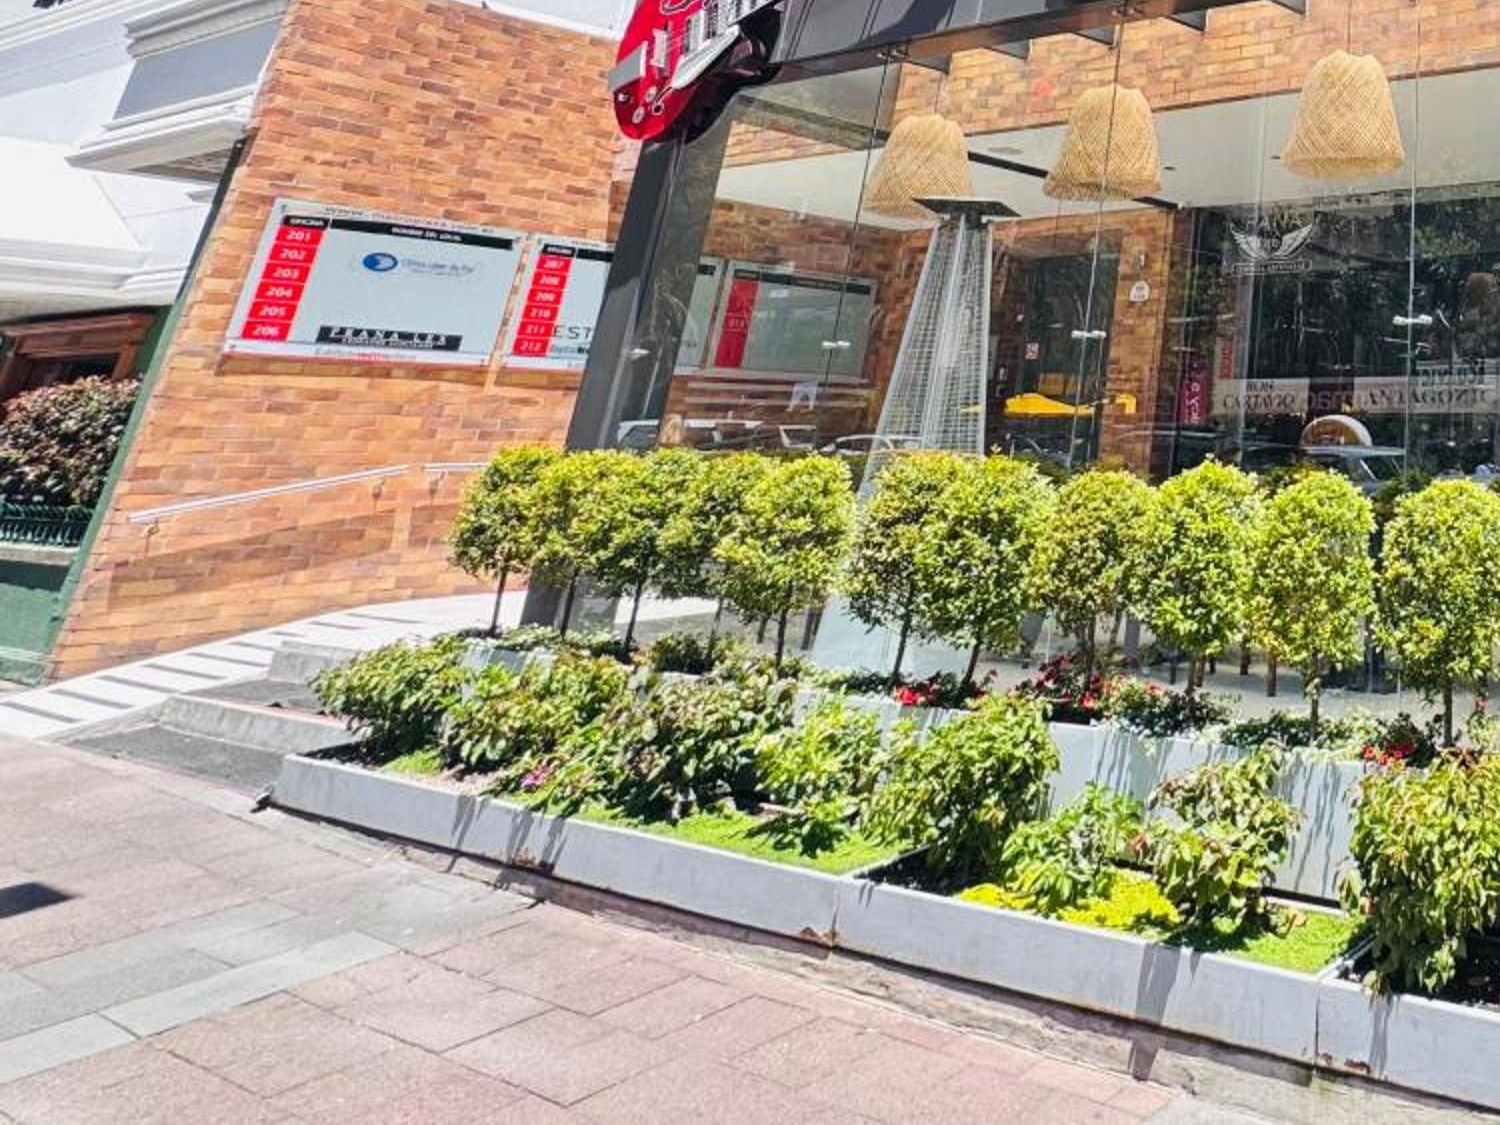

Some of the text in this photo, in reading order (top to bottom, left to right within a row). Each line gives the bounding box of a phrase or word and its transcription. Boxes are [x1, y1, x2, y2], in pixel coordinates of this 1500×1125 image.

[285, 229, 311, 243] 201
[280, 248, 307, 260] 202
[273, 267, 300, 279] 203
[266, 286, 293, 297] 204
[260, 305, 287, 317] 205
[252, 325, 280, 336] 206
